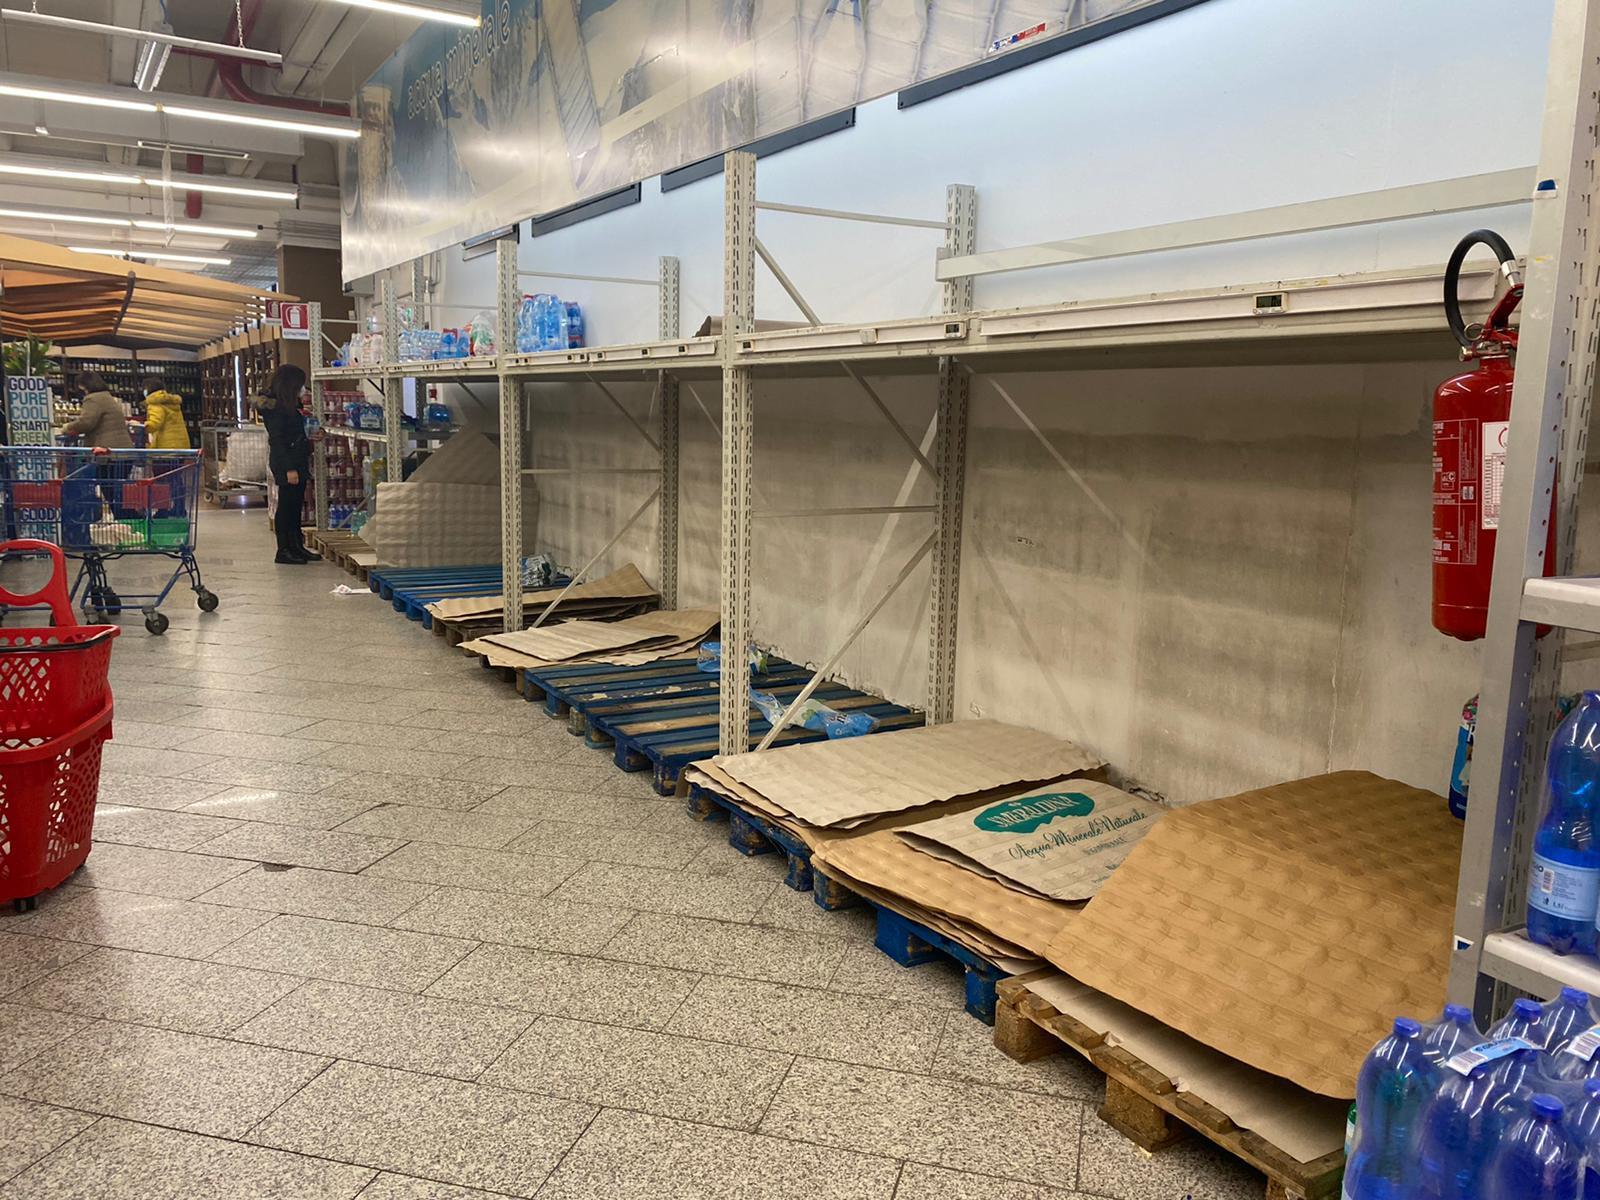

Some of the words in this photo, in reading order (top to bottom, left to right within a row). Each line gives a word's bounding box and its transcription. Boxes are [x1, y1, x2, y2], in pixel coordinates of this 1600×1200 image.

[407, 61, 444, 120] acqua
[446, 0, 511, 89] minerale
[9, 377, 46, 391] GOOD
[9, 392, 48, 405] PURE
[11, 406, 48, 420] COOL
[13, 420, 49, 431] SMART
[13, 431, 50, 443] GREEN
[1008, 843, 1055, 861] Acqua
[1043, 821, 1104, 847] Minerale
[1095, 808, 1148, 833] Naturale
